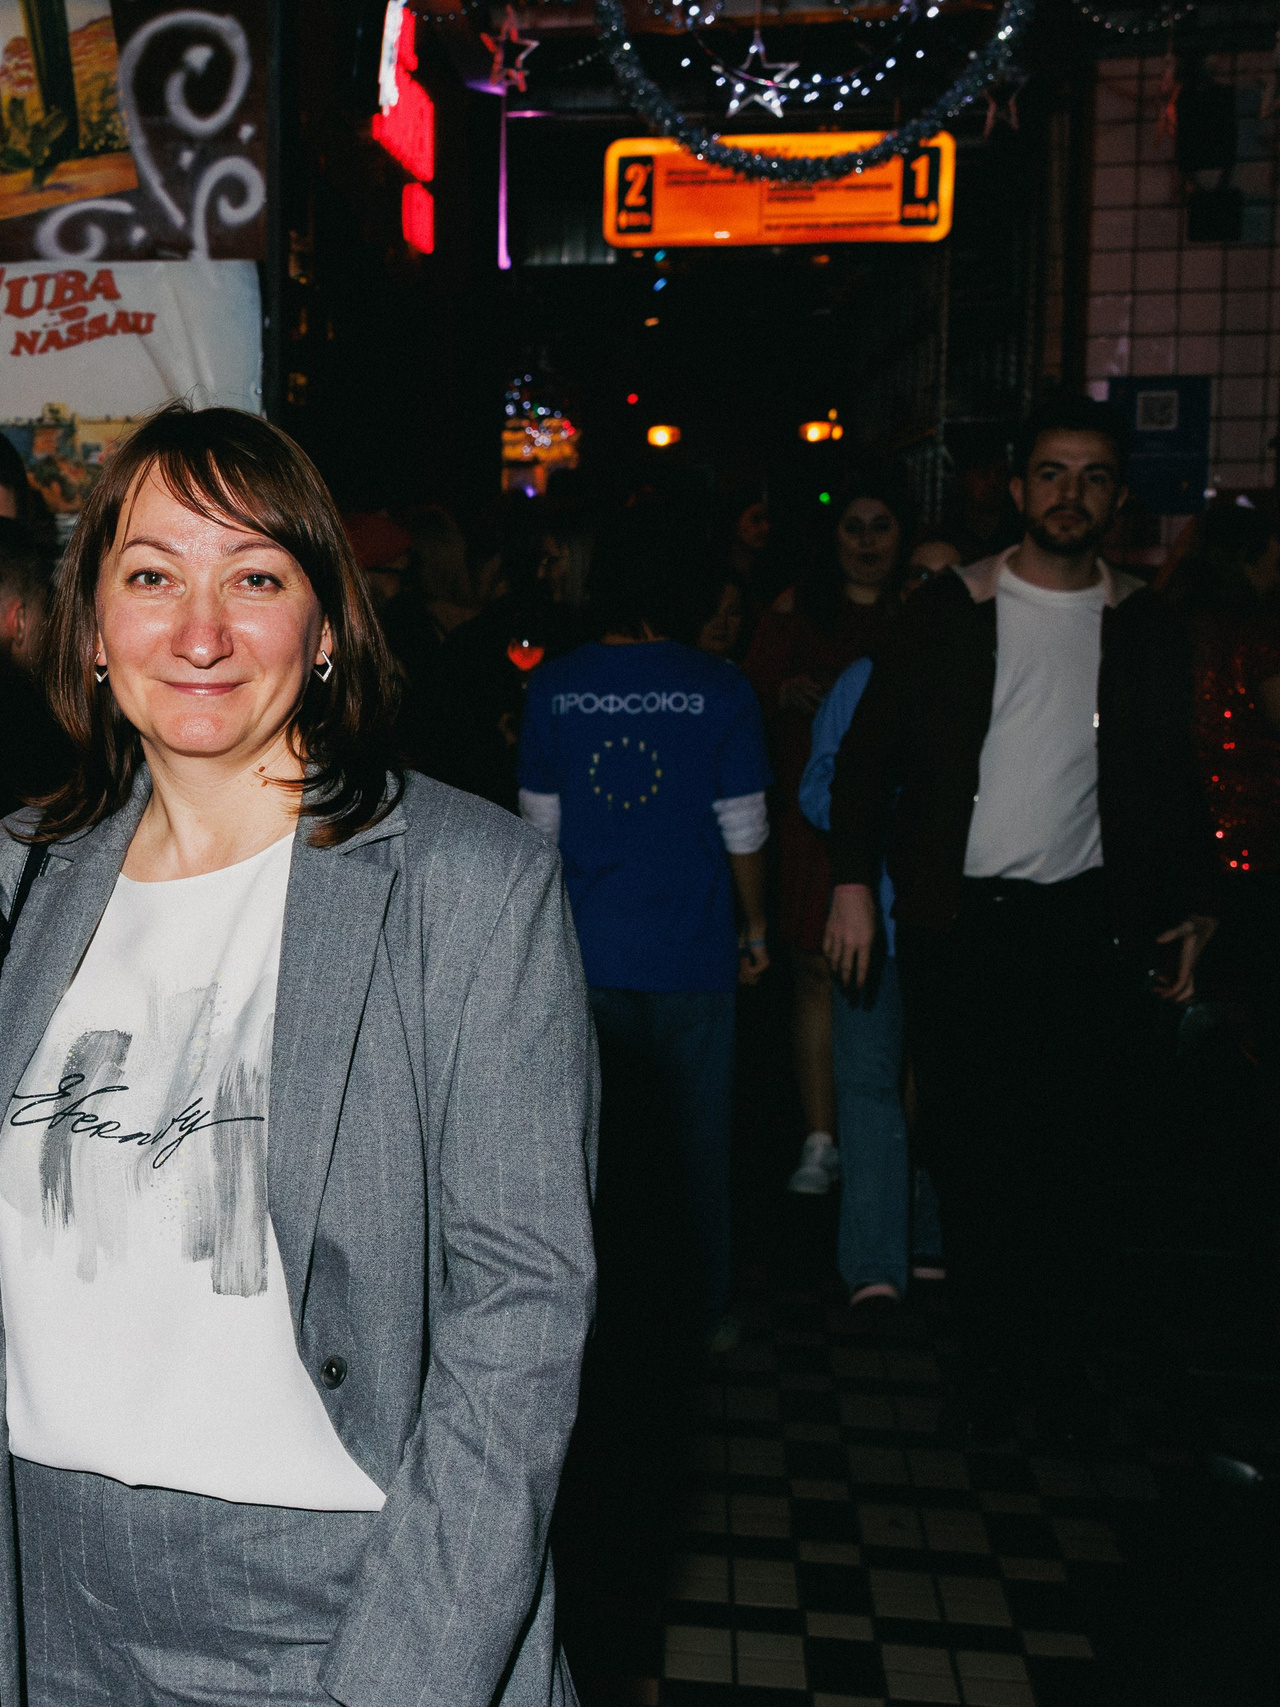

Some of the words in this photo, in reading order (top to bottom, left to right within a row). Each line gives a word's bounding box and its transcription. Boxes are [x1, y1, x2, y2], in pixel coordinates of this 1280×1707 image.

[910, 154, 930, 199] 1
[10, 311, 157, 356] NASSAU
[552, 691, 705, 715] ПРОФСОЮЗ
